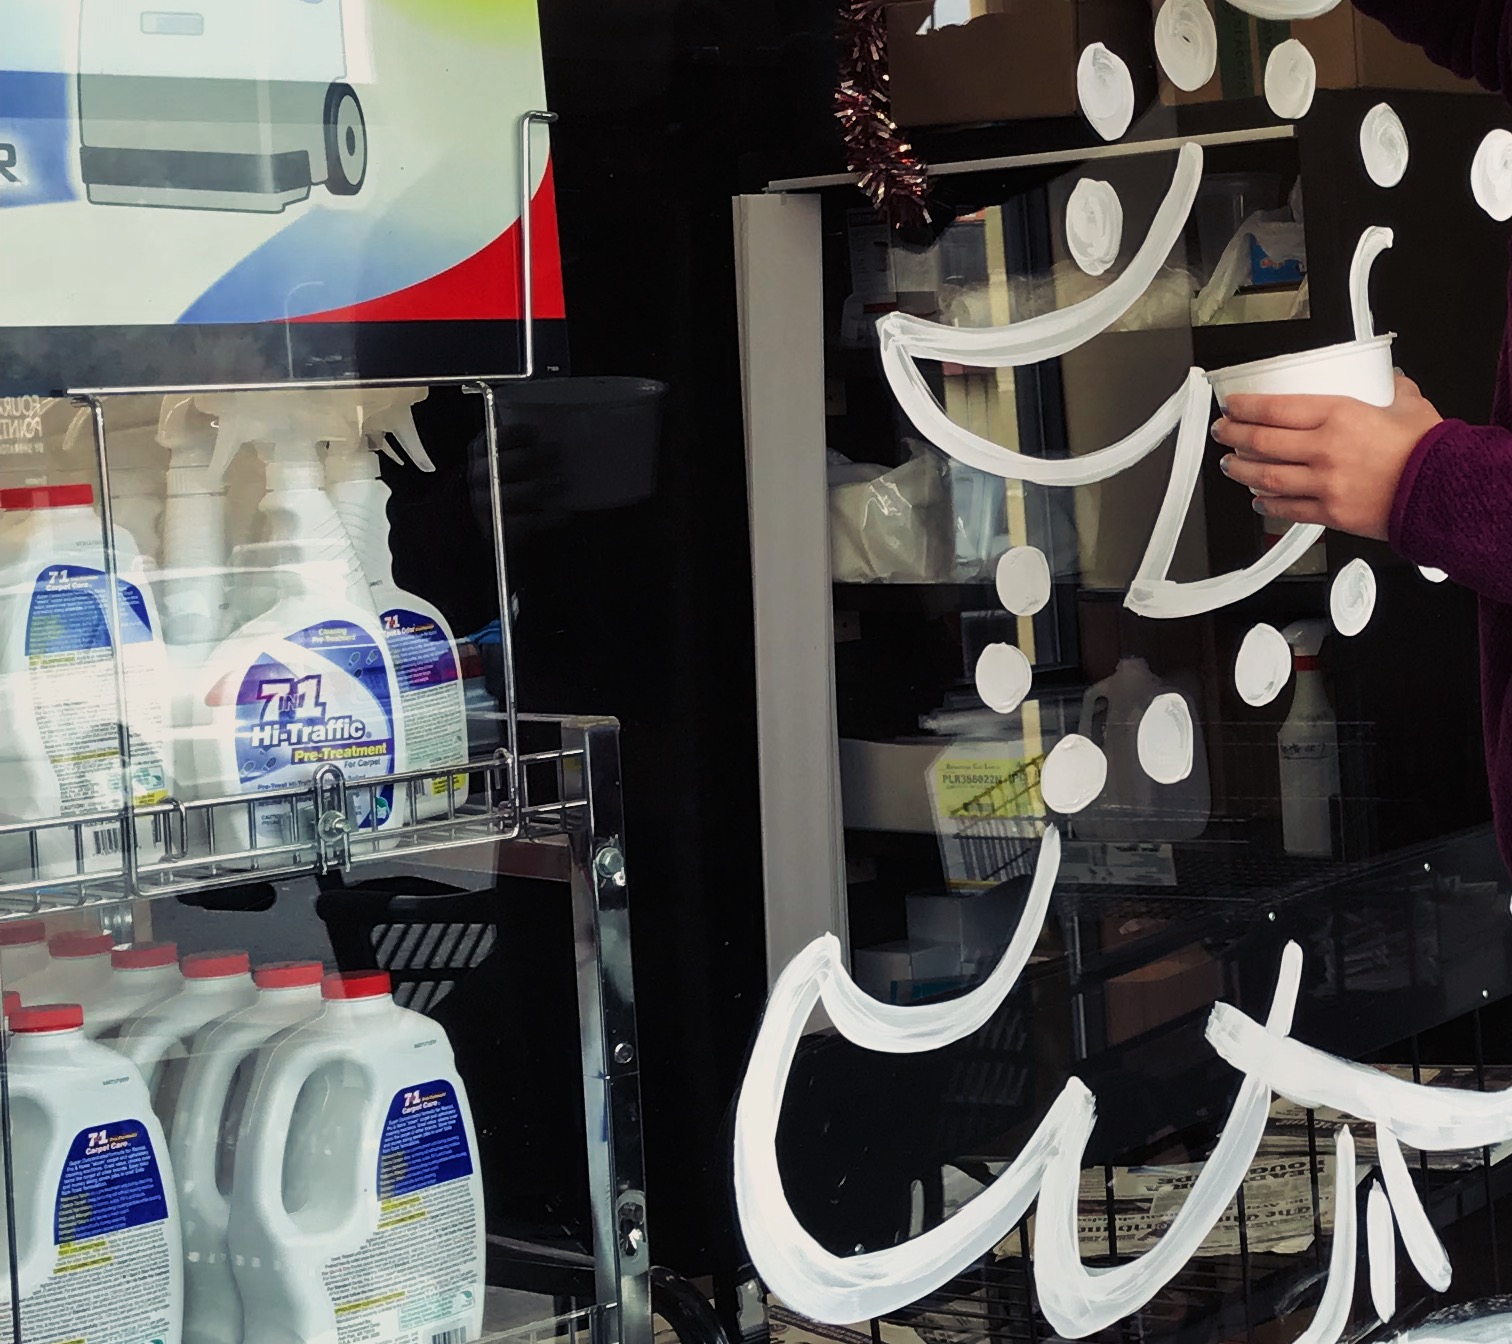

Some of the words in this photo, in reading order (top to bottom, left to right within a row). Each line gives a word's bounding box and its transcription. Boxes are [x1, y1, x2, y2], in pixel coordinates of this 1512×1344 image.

[250, 714, 366, 748] Hi-Traffic
[294, 742, 387, 763] Pre-Treatment
[344, 760, 356, 769] For
[357, 758, 381, 769] Carpet
